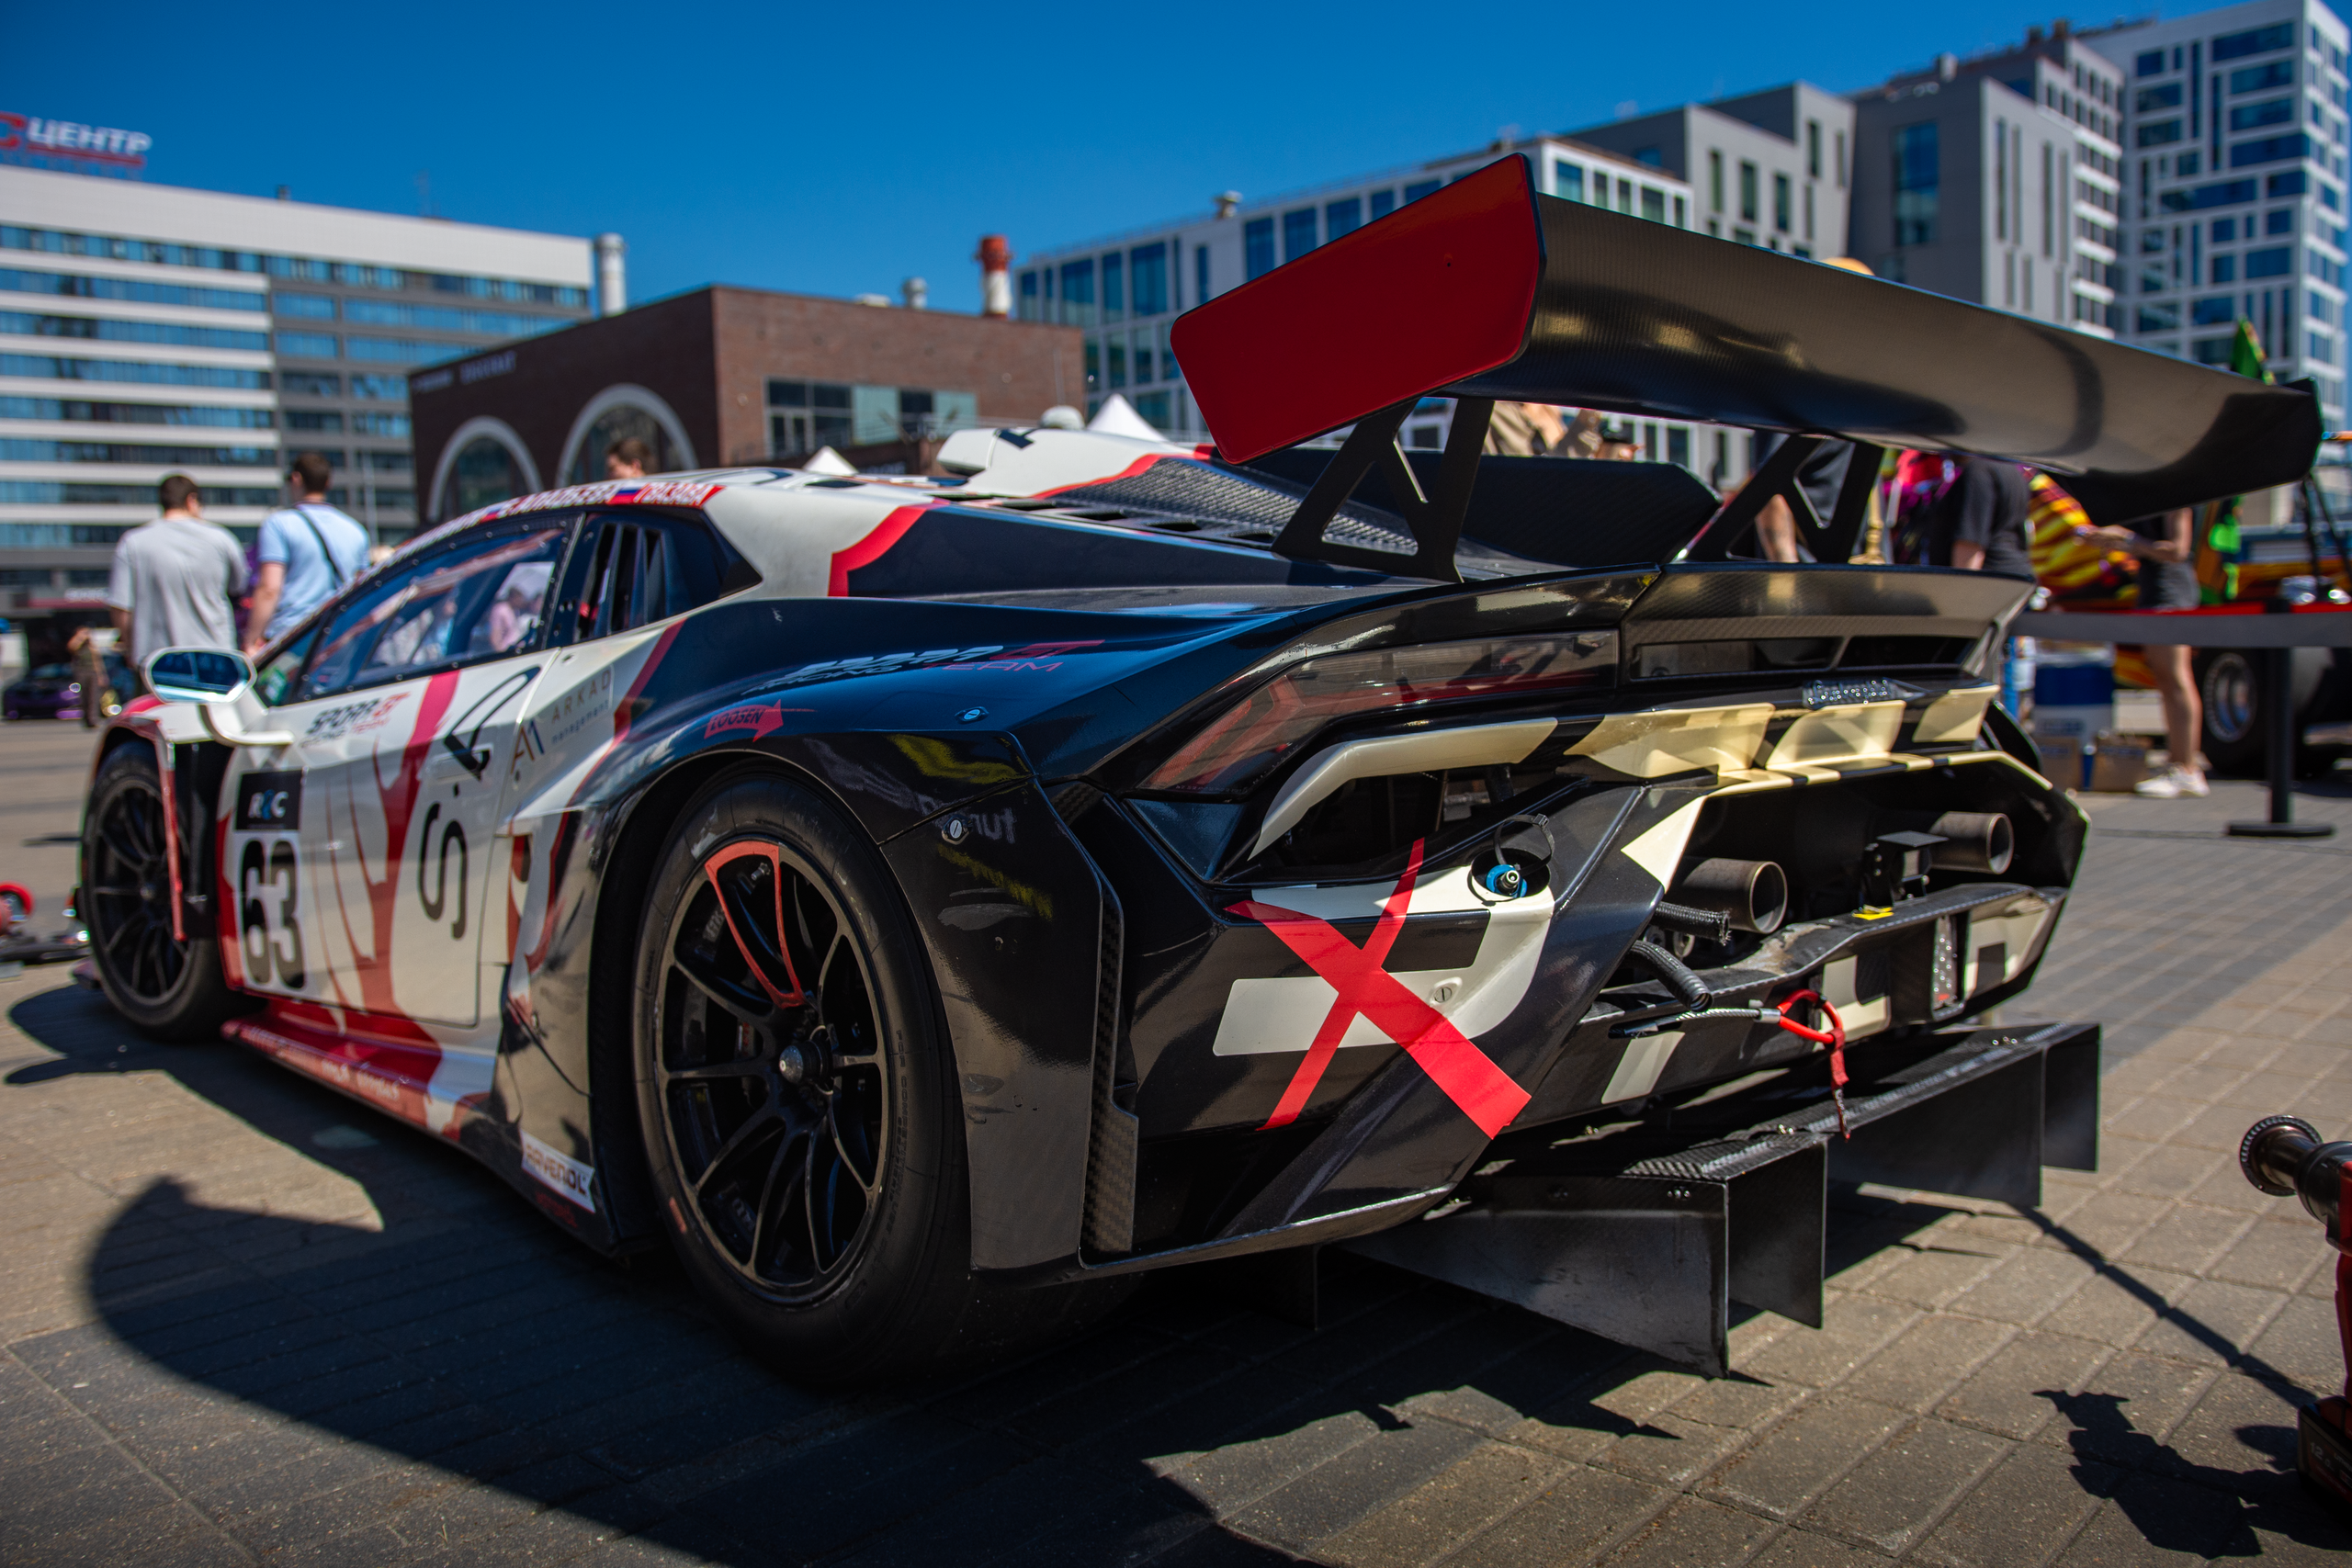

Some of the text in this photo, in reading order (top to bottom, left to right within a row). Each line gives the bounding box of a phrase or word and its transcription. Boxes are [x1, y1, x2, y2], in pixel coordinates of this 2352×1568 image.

[27, 116, 153, 156] ЦЕНТР
[922, 660, 1054, 673] TEAM
[989, 639, 1106, 661] GT
[552, 669, 613, 724] ARKAD
[711, 708, 763, 731] LOOSEN
[241, 837, 307, 989] 63
[896, 1030, 906, 1067] FOR
[893, 1076, 908, 1197] COMPETITION
[526, 1143, 587, 1197] RAVENOL
